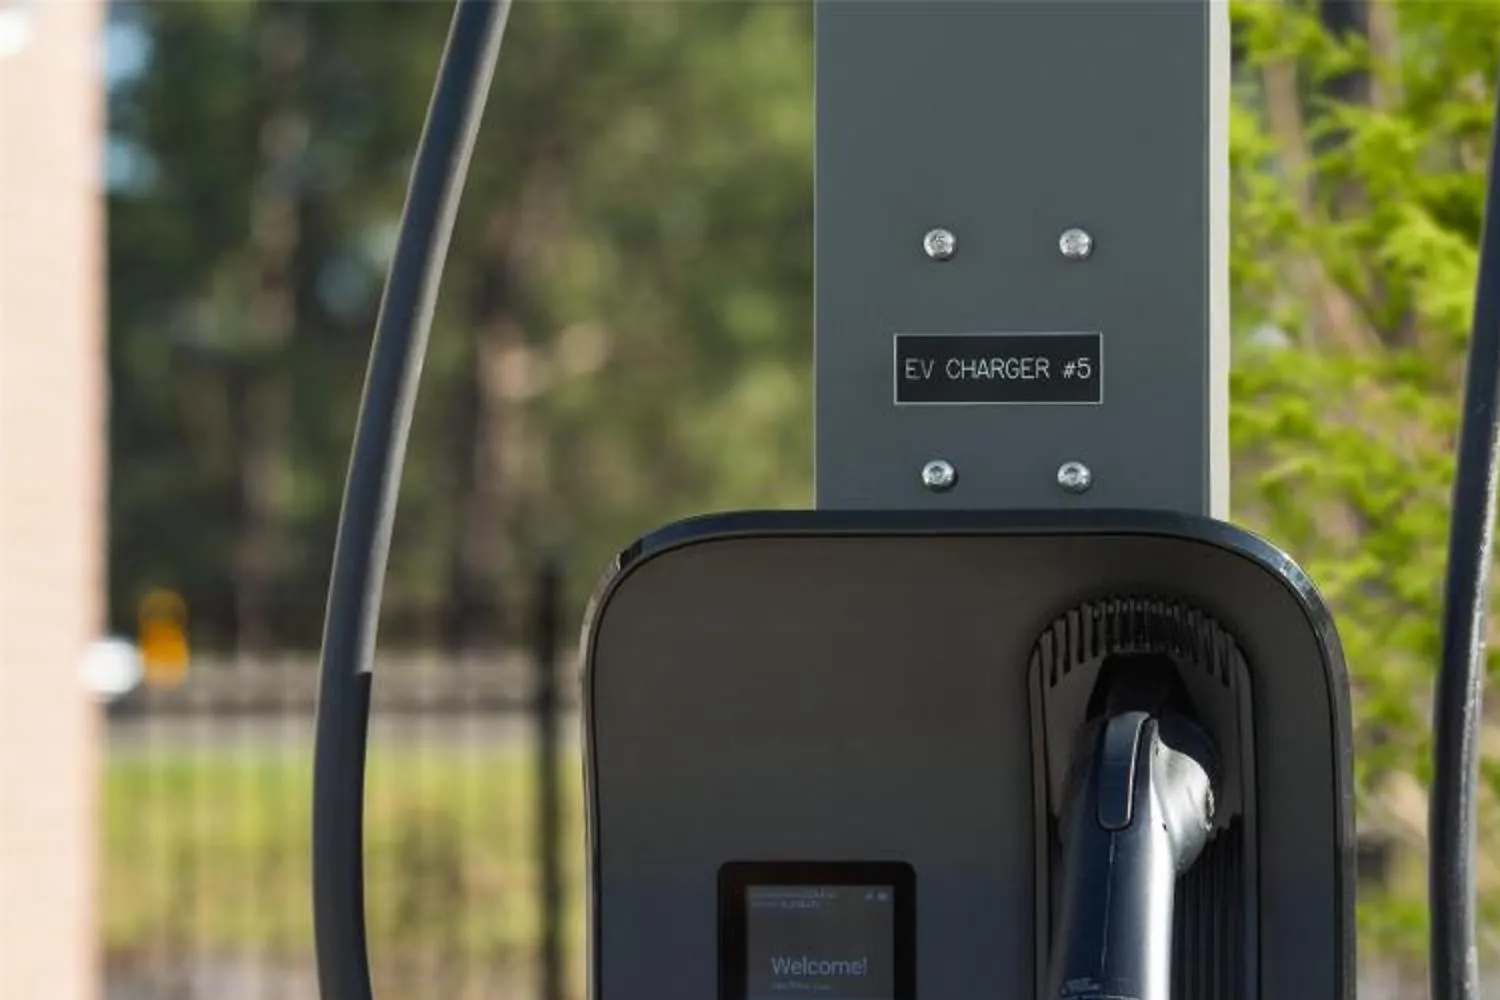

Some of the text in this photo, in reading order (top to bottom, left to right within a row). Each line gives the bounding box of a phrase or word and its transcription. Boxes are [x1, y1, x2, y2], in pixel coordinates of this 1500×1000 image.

[904, 357, 1092, 379] EV CHARGER #5
[771, 955, 868, 976] Welcome!
